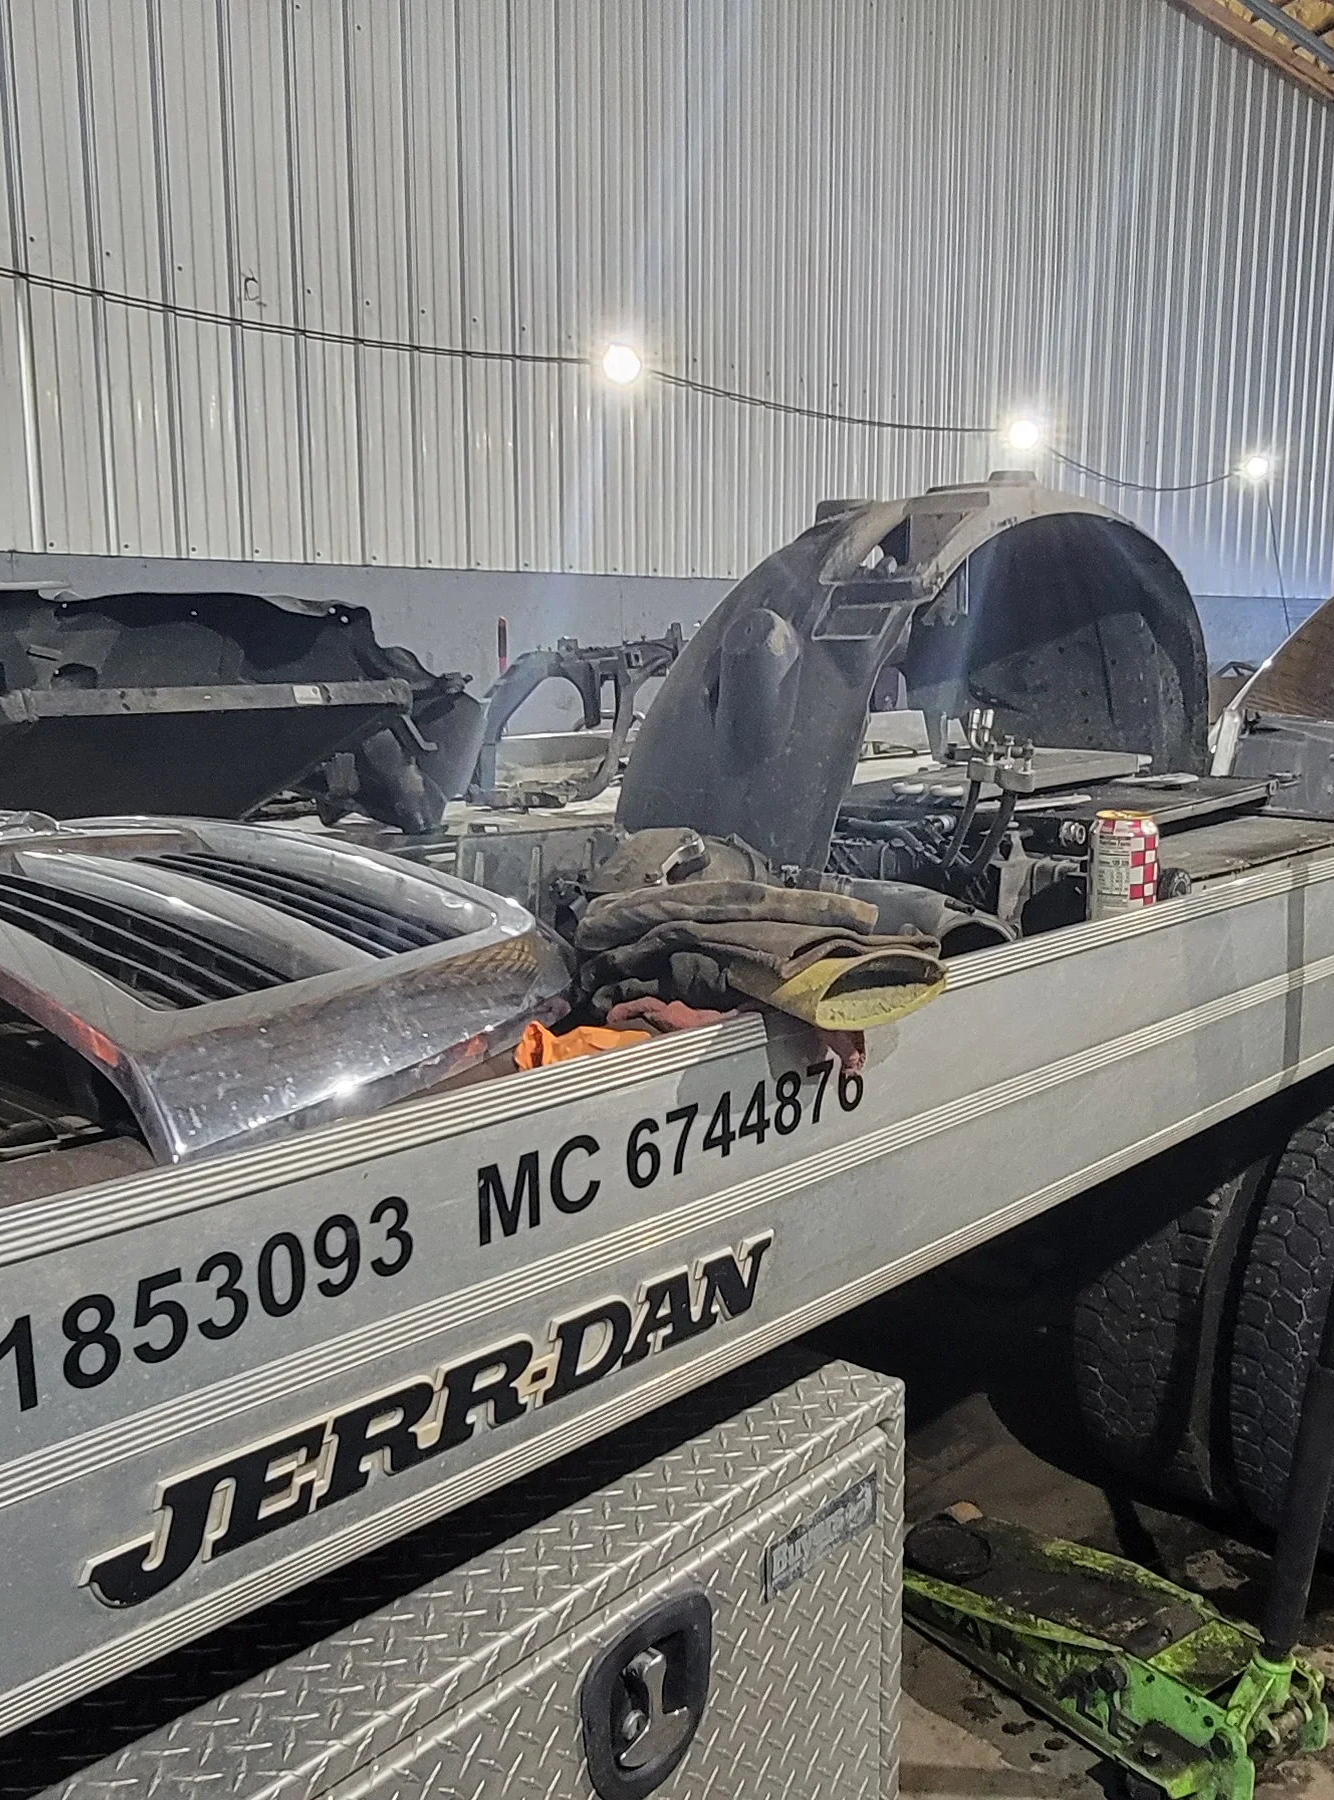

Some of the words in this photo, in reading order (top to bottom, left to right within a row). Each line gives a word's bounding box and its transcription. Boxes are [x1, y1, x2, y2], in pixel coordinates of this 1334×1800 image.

[477, 1134, 602, 1246] MC
[625, 1056, 865, 1190] 6744876
[79, 1230, 774, 1608] JERR-DAN
